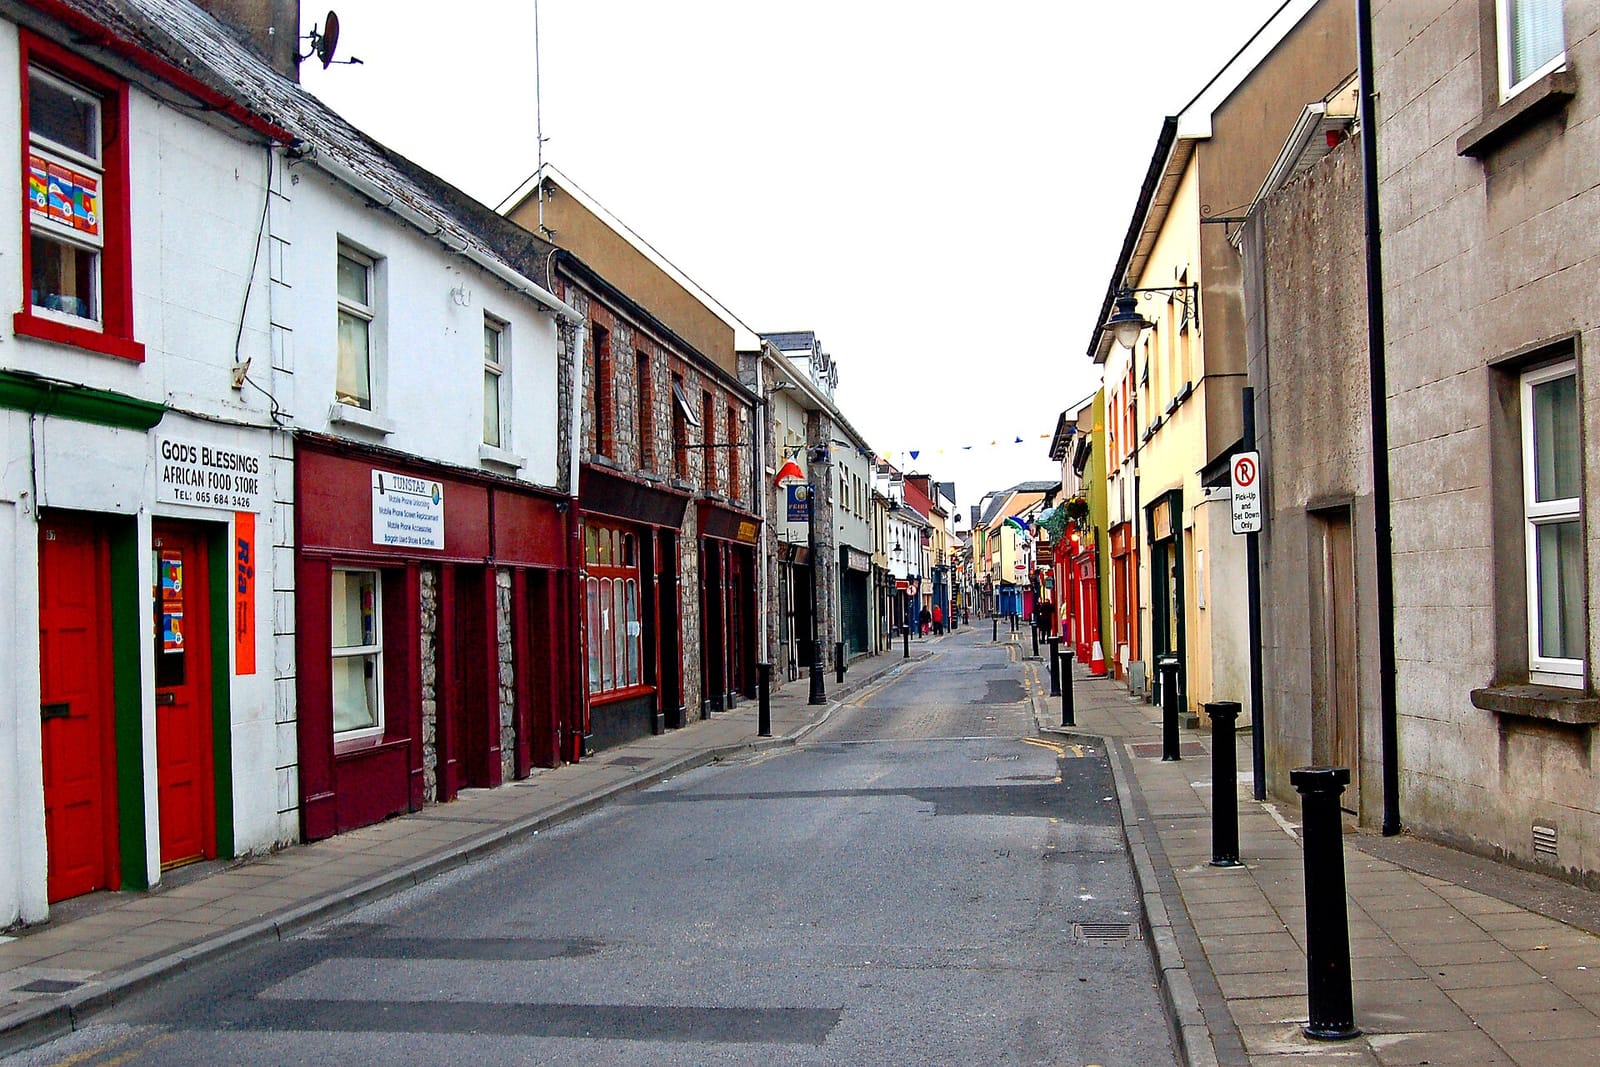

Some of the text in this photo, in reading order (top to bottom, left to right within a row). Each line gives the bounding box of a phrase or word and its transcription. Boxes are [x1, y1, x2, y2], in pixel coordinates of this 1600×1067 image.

[161, 439, 259, 474] GOD'S BLESSINGS
[163, 465, 259, 495] AFRICAN FOOD STORE
[393, 475, 426, 493] TUNSTAR
[195, 491, 210, 503] 065
[213, 493, 229, 505] 684
[232, 495, 250, 508] 3426
[1235, 492, 1256, 501] Pick-Up
[1244, 511, 1260, 519] Down
[1240, 521, 1253, 530] Only
[238, 537, 253, 595] Ria
